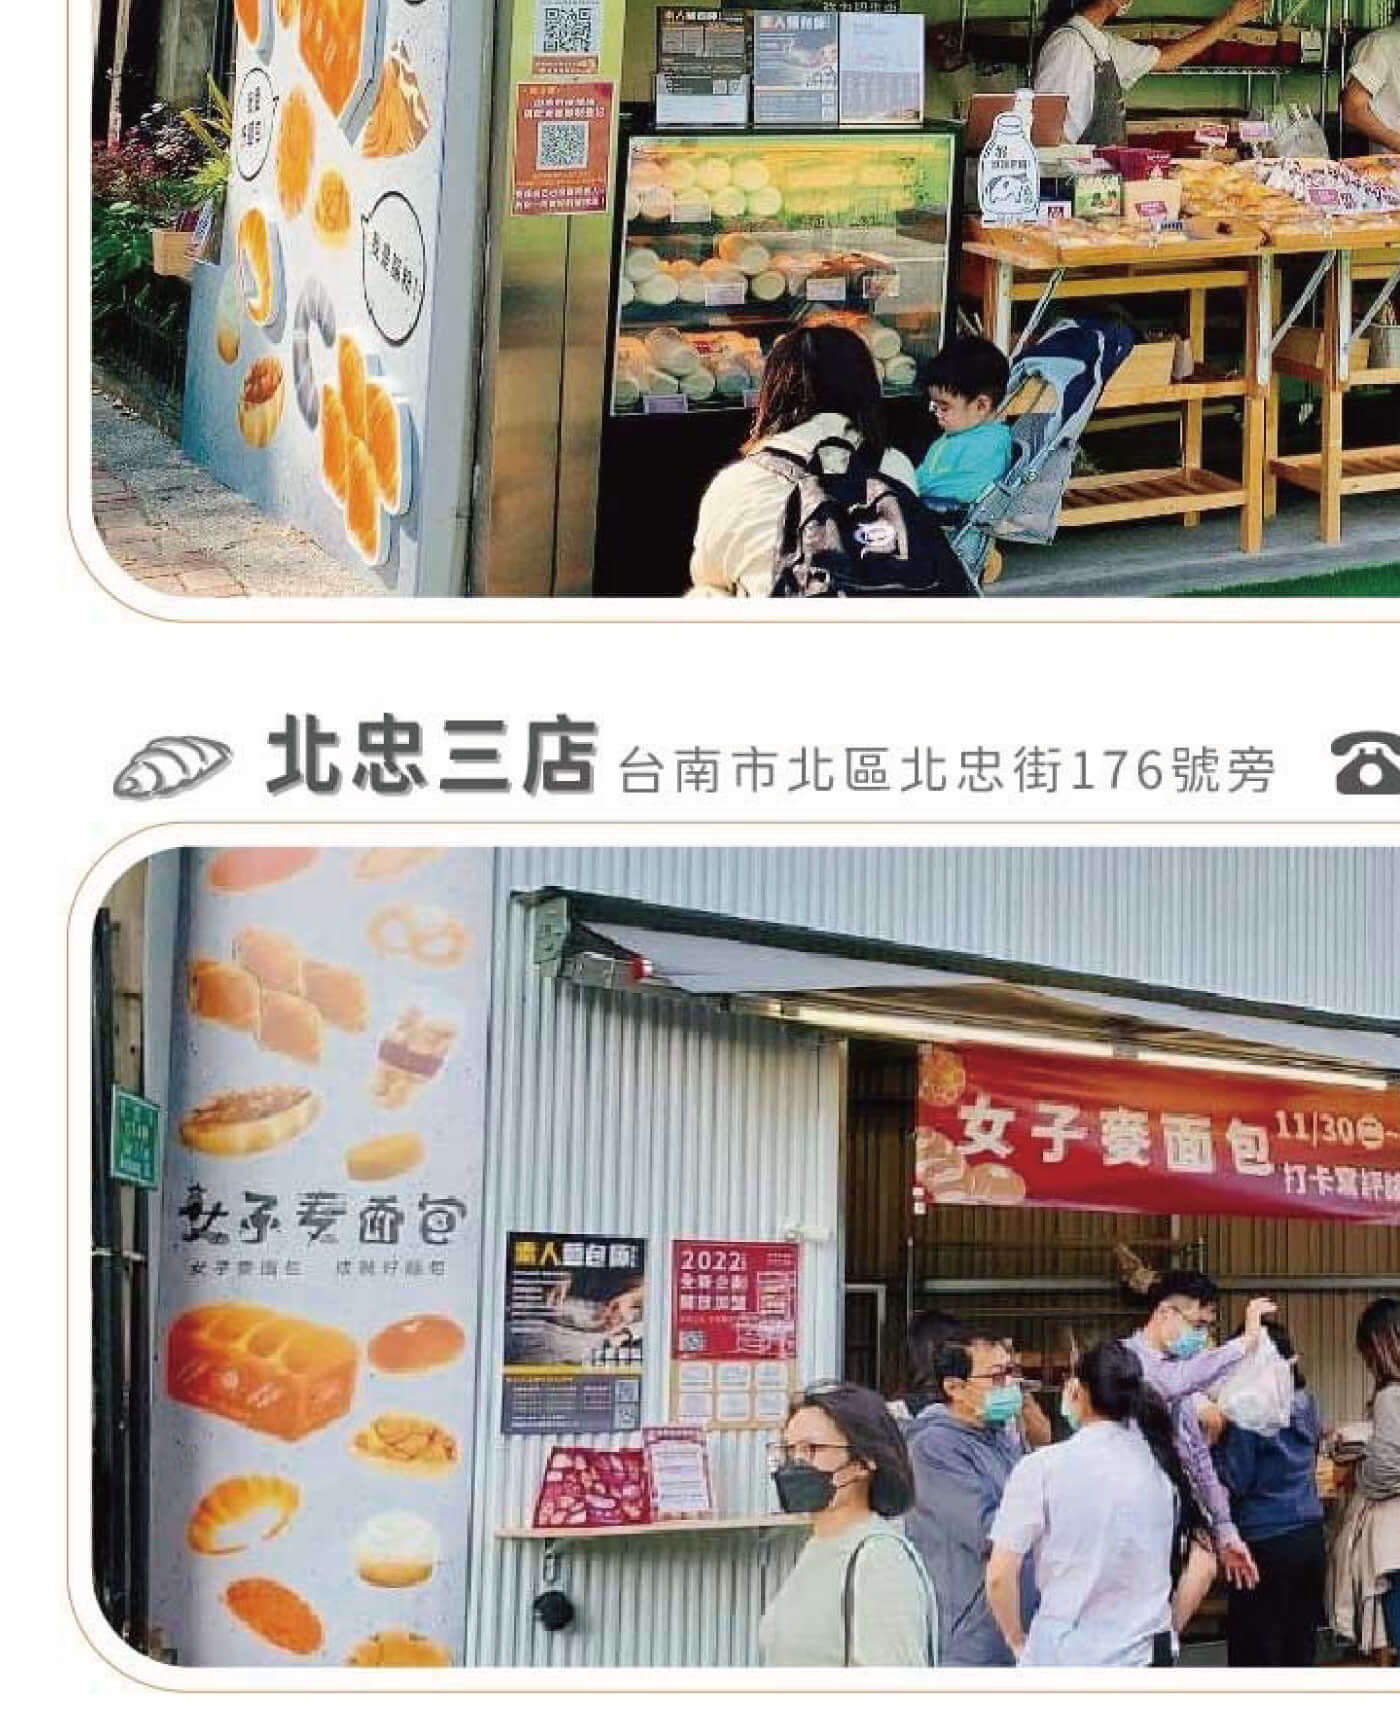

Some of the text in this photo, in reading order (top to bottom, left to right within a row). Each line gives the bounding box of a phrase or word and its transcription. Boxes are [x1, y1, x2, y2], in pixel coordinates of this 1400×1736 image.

[957, 1093, 1275, 1177] 女子麥面包
[178, 1182, 468, 1246] 女子麥面包
